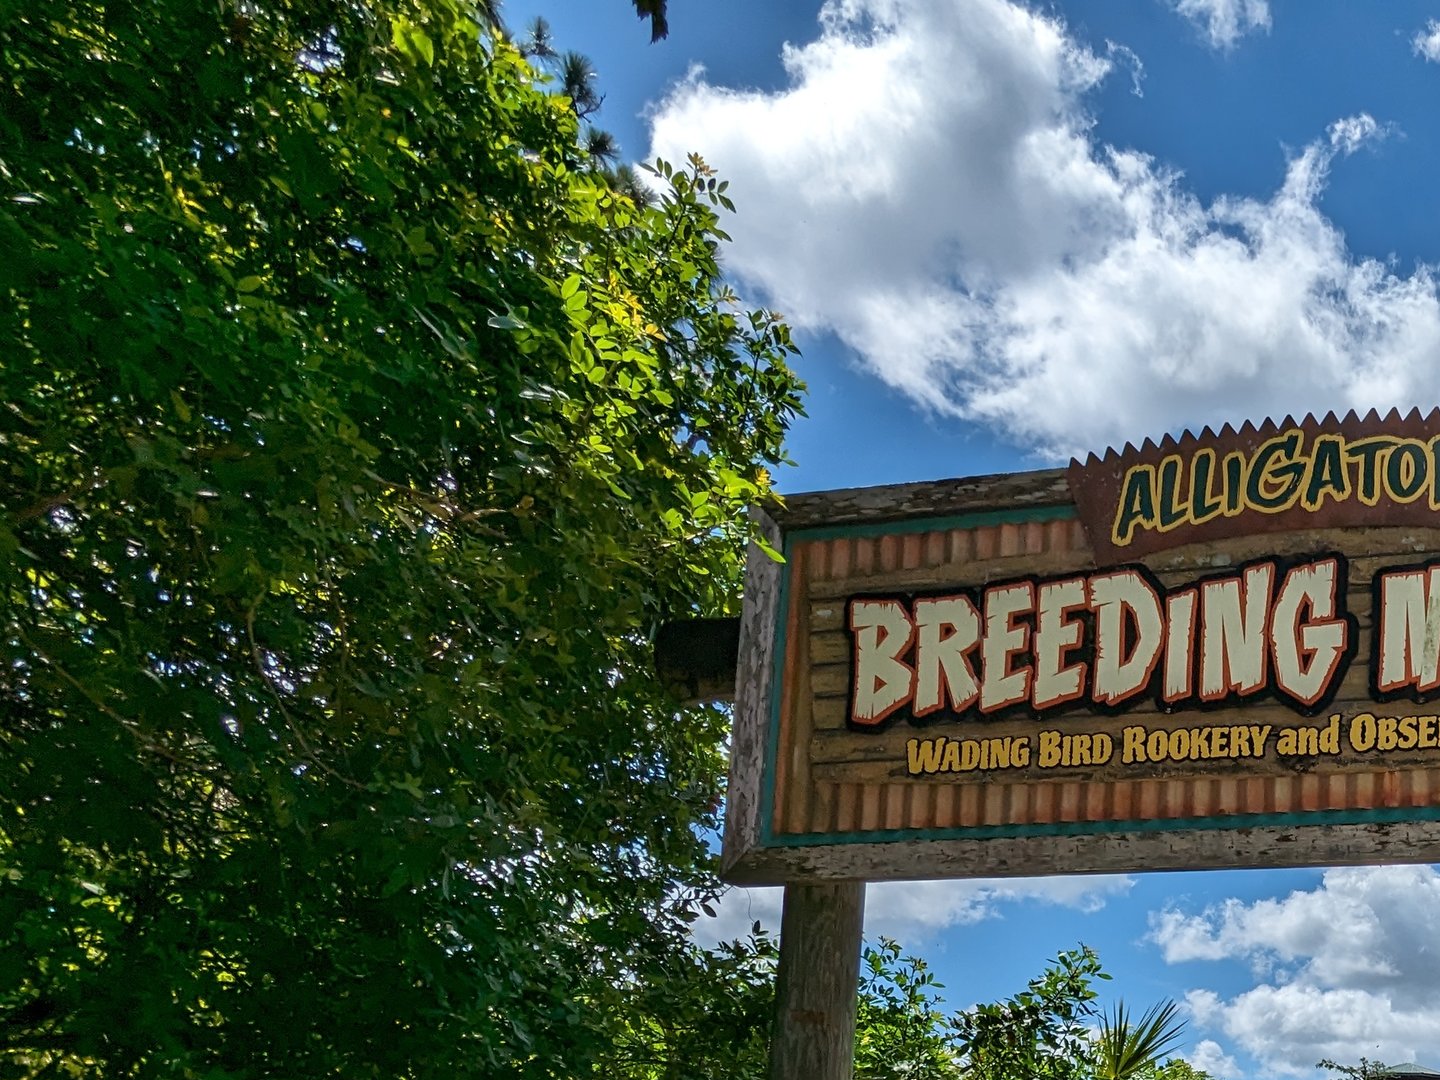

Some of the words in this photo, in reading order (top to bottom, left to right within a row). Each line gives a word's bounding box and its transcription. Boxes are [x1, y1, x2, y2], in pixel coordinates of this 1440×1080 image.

[849, 557, 1348, 726] BREEDING
[906, 736, 1030, 774] WADING
[1038, 729, 1112, 769] BIRD
[1121, 725, 1272, 764] ROOKERY
[1275, 713, 1341, 757] and
